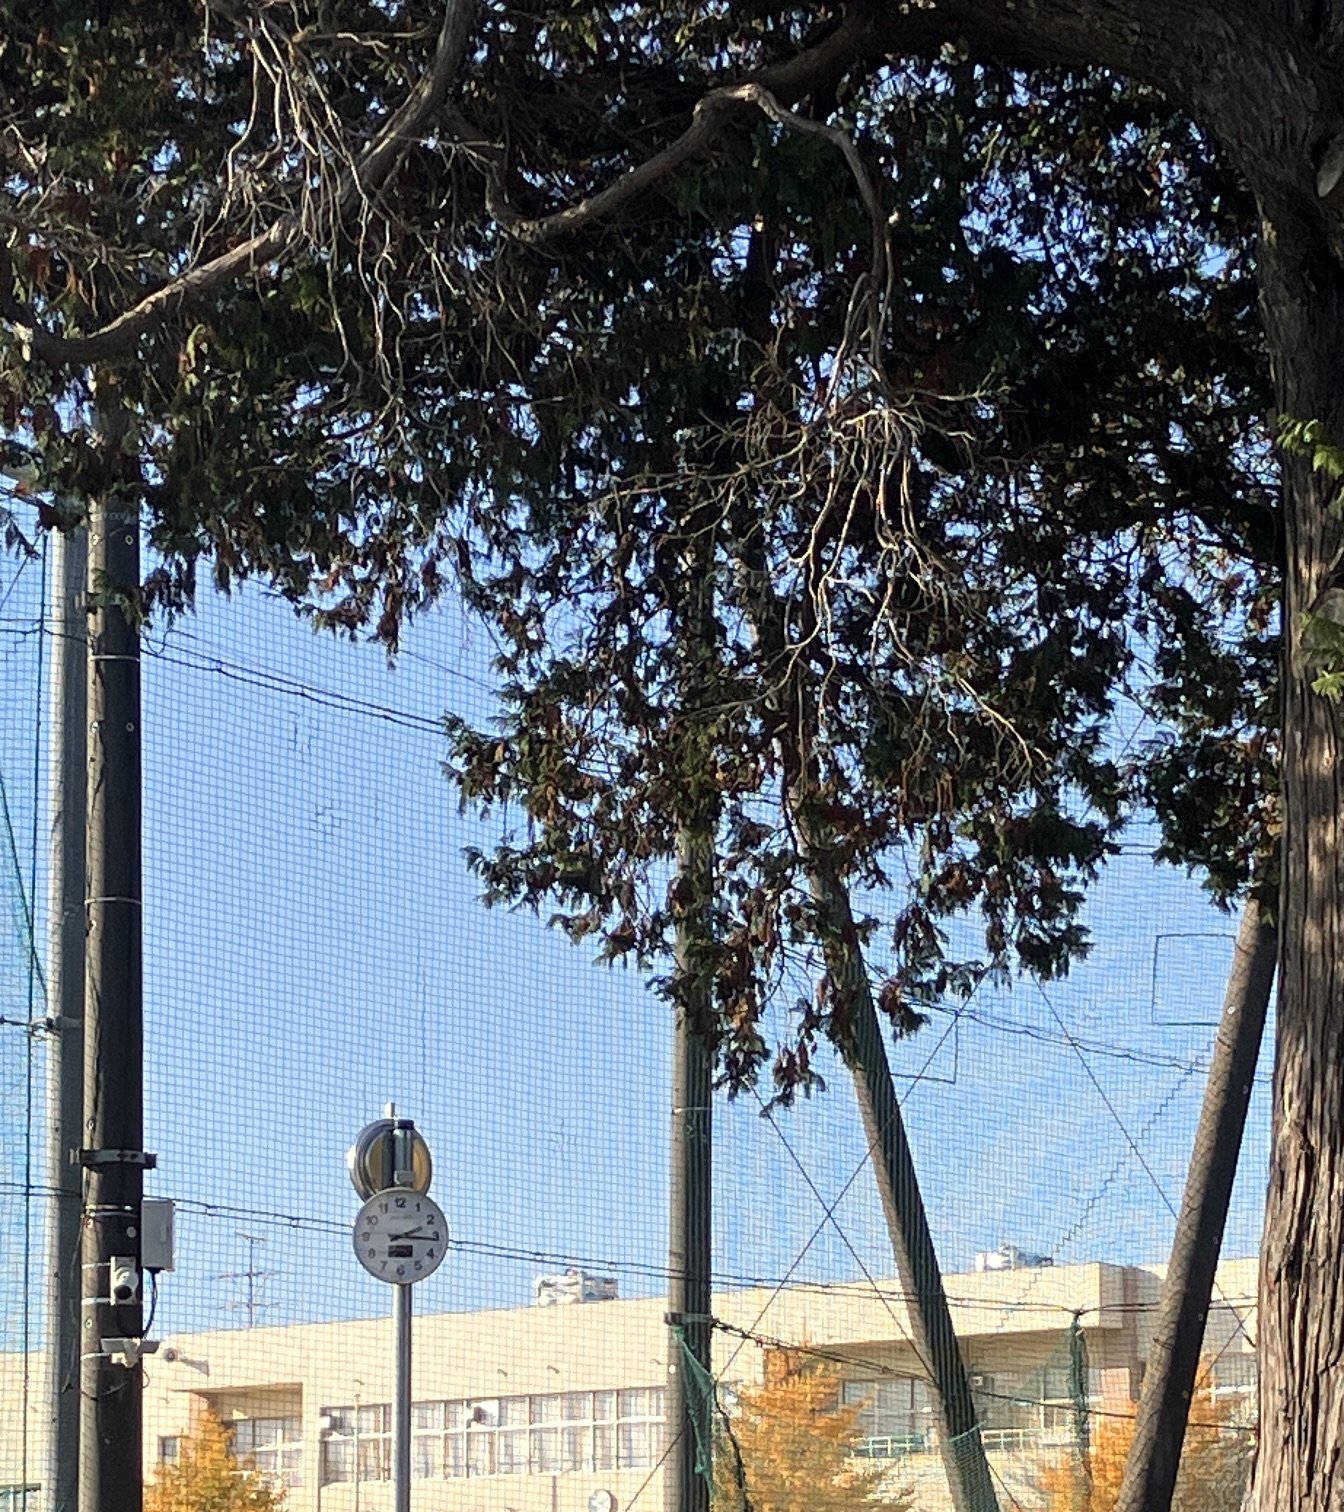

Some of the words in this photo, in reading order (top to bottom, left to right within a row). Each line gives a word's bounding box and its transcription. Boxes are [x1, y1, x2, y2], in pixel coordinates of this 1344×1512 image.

[394, 1197, 406, 1208] 12
[416, 1203, 421, 1212] 1
[427, 1215, 434, 1225] 2
[432, 1231, 439, 1241] 3
[426, 1248, 435, 1259] 4
[380, 1261, 388, 1270] 7
[396, 1265, 405, 1275] 6
[414, 1261, 423, 1270] 5
